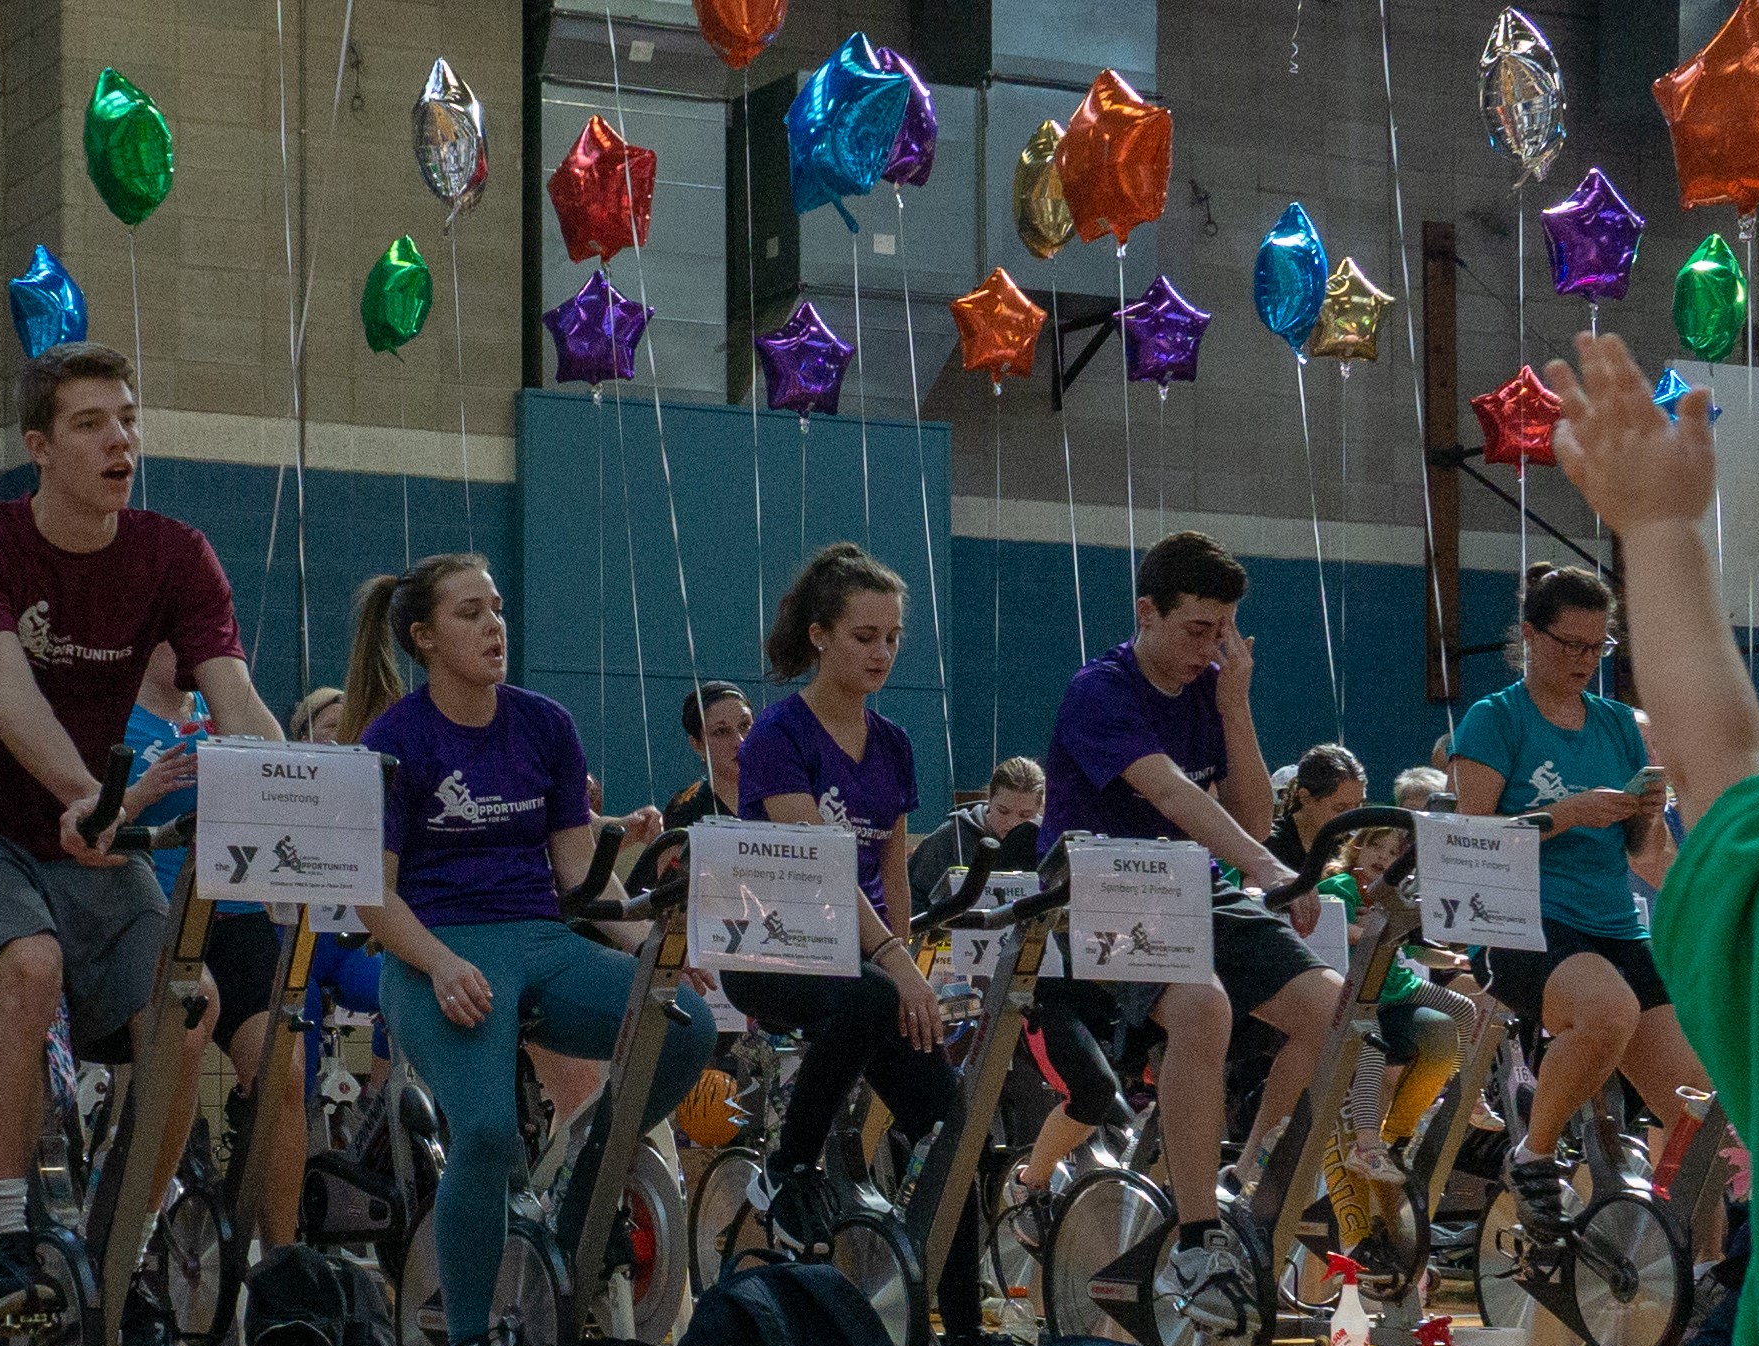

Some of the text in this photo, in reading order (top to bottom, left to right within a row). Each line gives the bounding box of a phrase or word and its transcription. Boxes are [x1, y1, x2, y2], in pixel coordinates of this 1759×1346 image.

[261, 763, 319, 780] SALLY
[261, 791, 319, 806] Livestrong
[738, 841, 818, 860] DANIELLE
[1446, 834, 1501, 851] ANDREW
[1113, 859, 1168, 874] SKYLER
[1516, 1067, 1529, 1082] 16
